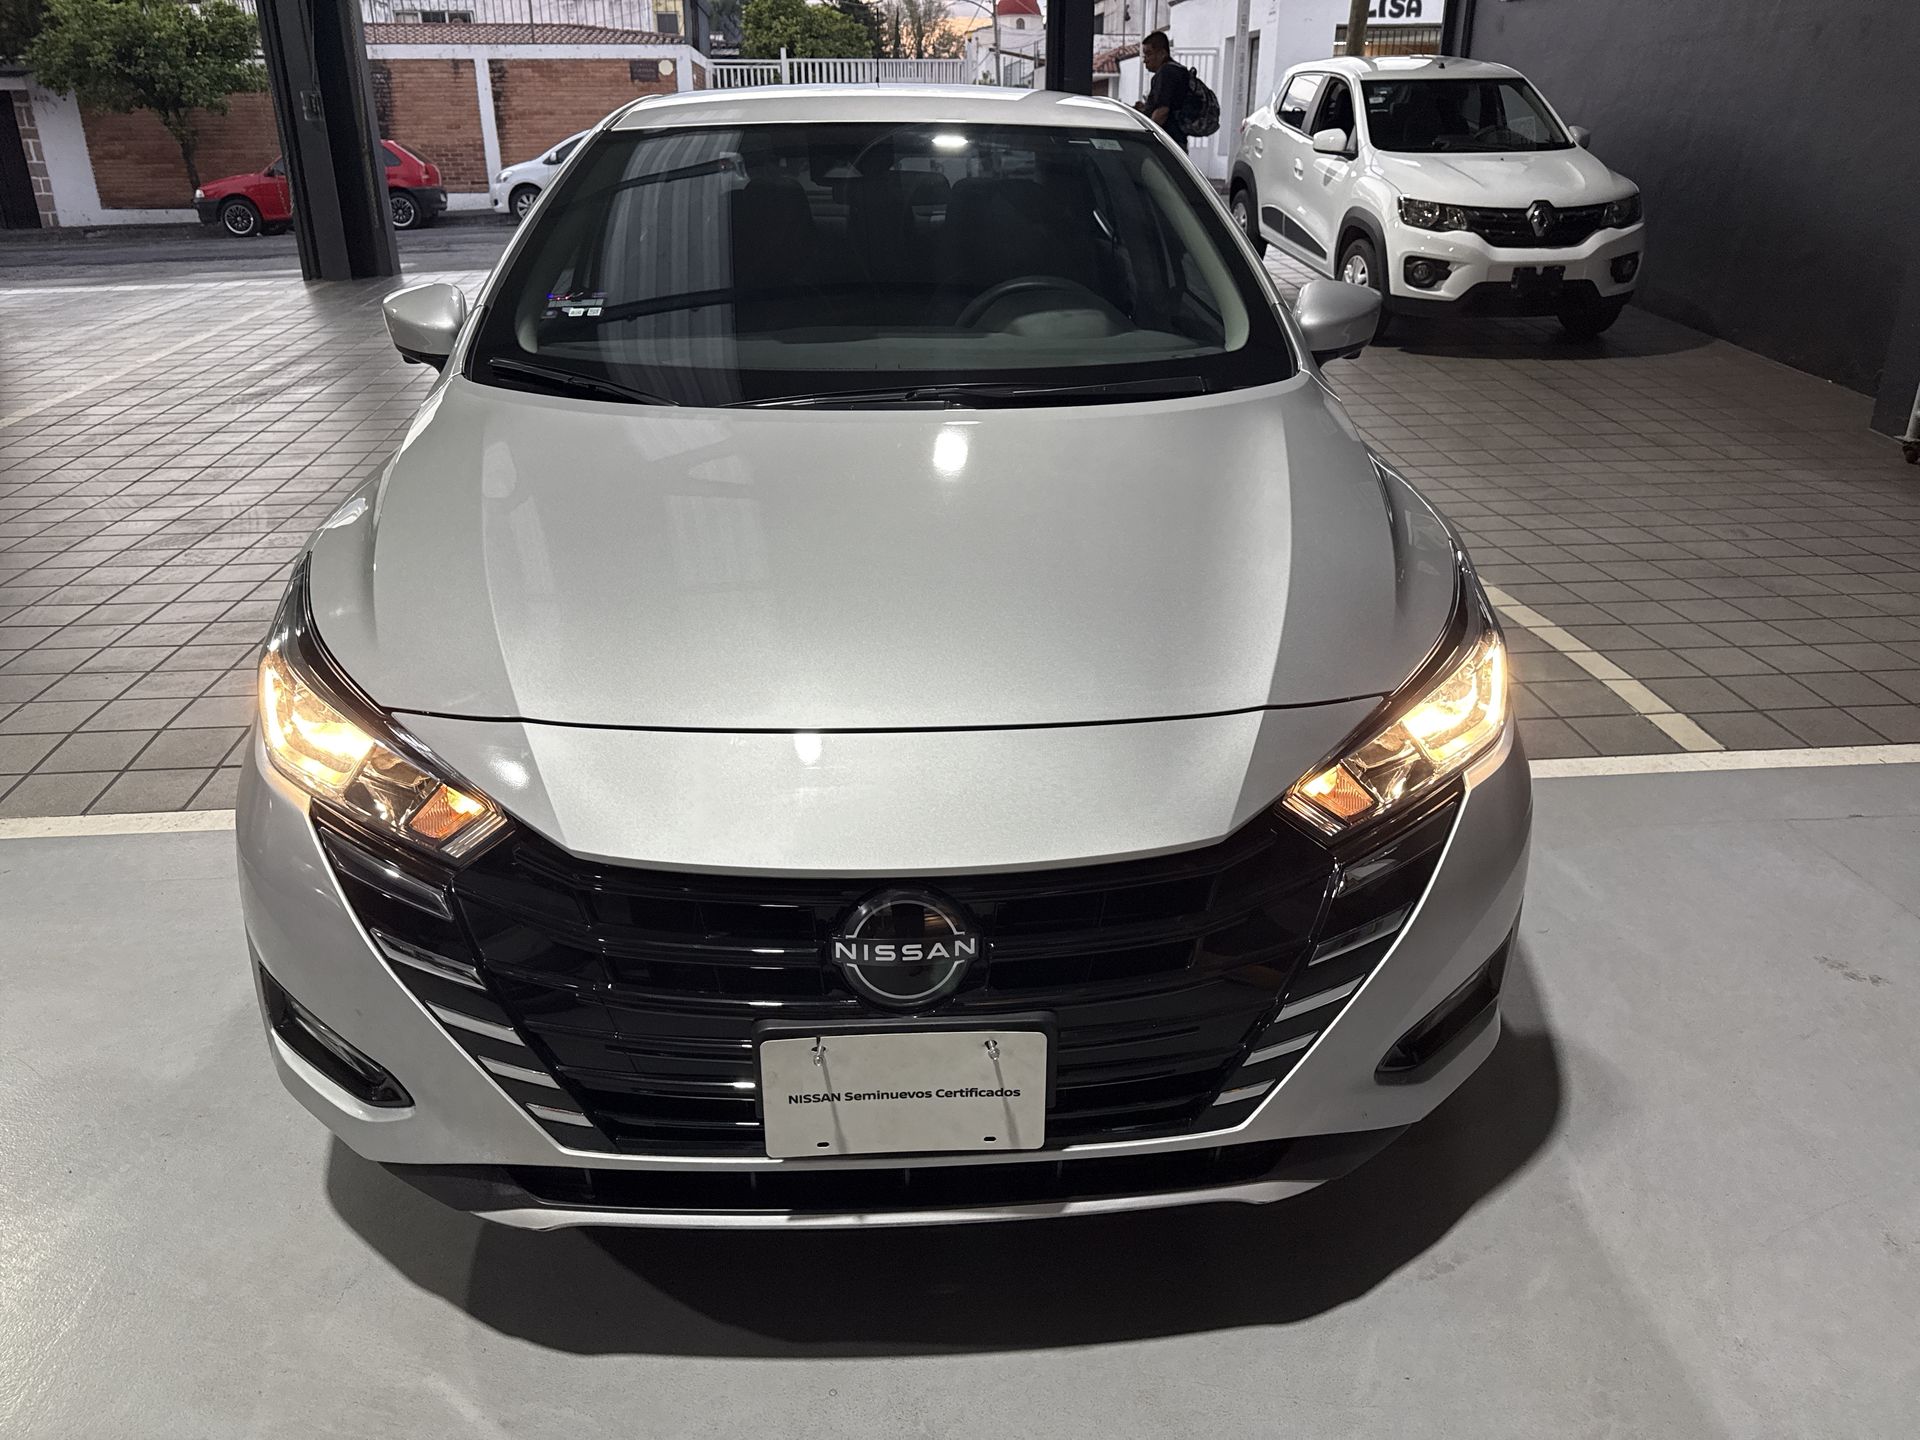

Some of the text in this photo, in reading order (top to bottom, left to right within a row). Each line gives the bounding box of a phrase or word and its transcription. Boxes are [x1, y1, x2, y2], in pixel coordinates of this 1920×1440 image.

[835, 937, 976, 962] NISSAN
[788, 1087, 1021, 1105] NISSAN Seminuevos Certificados
